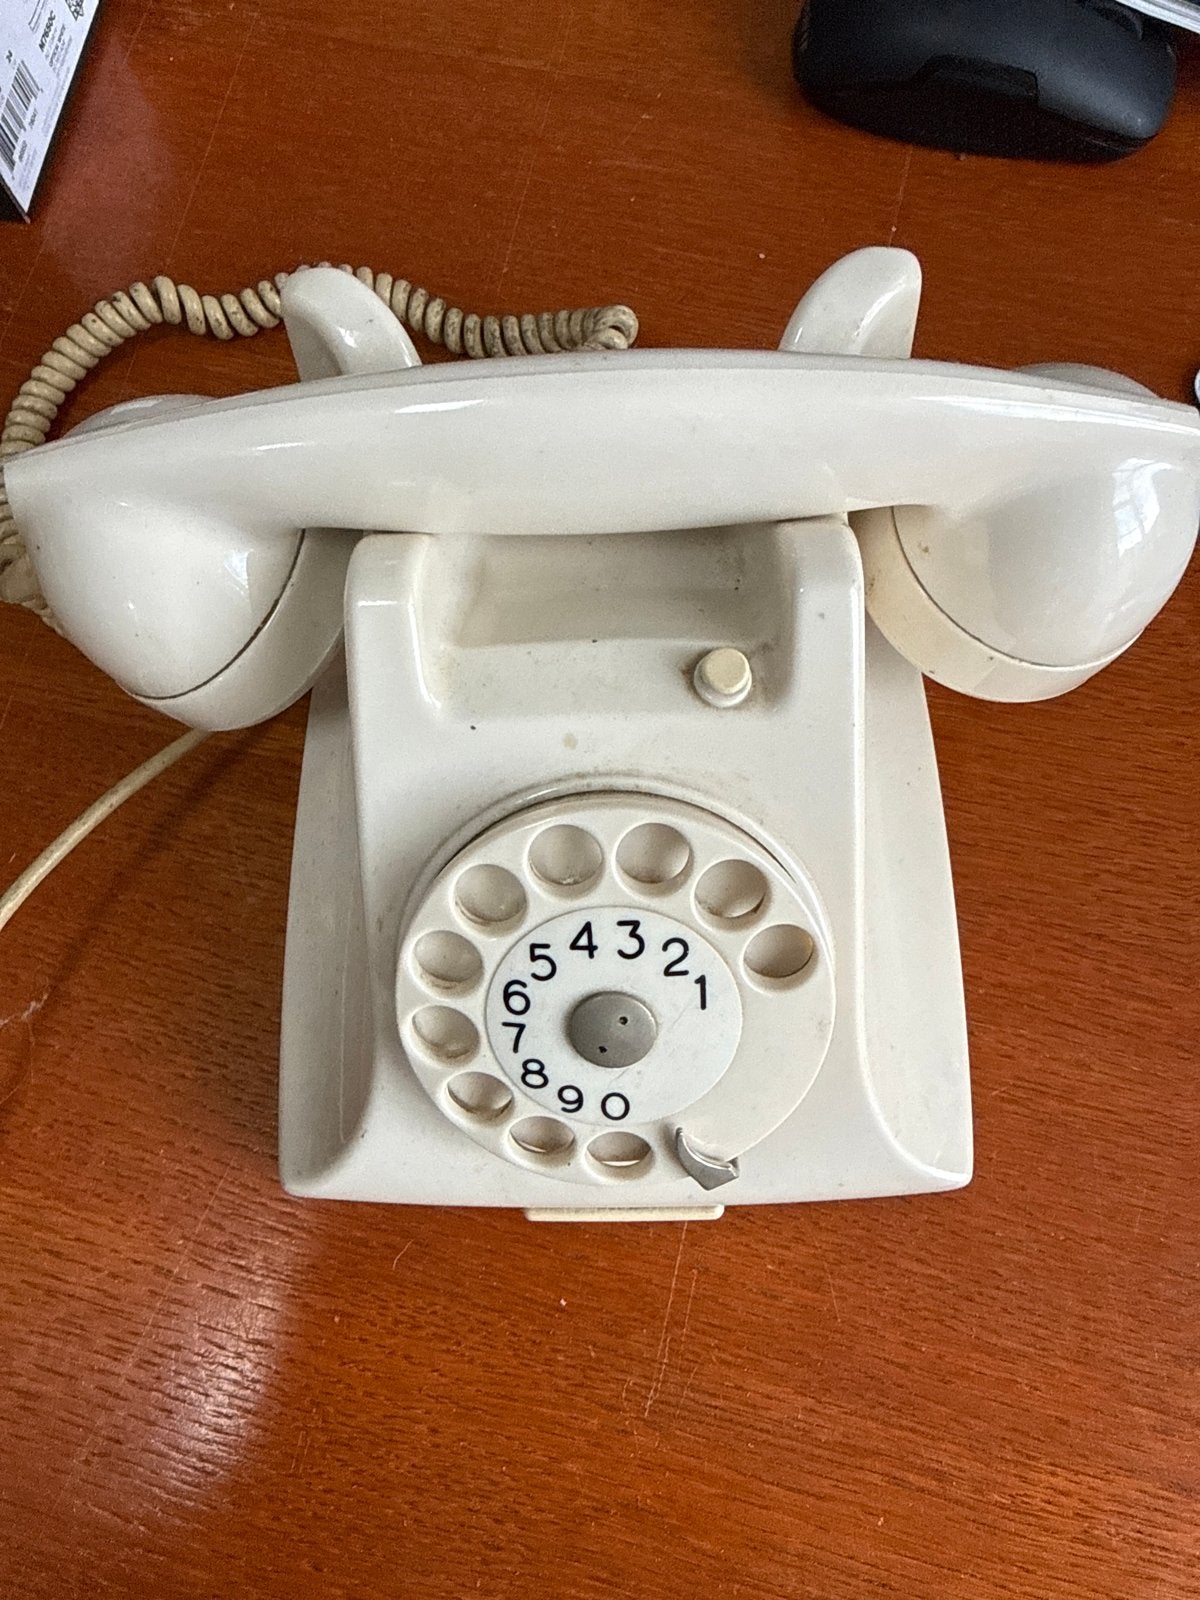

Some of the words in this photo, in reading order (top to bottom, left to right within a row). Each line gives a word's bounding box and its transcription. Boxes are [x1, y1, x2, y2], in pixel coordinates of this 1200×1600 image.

[569, 921, 599, 960] 4
[616, 919, 646, 960] 3
[661, 937, 690, 977] 2
[529, 942, 557, 982] 5
[502, 979, 531, 1016] 6
[694, 974, 707, 1011] 1
[501, 1021, 526, 1054] 7
[520, 1058, 549, 1090] 8
[557, 1084, 584, 1114] 9
[600, 1091, 631, 1121] 0
